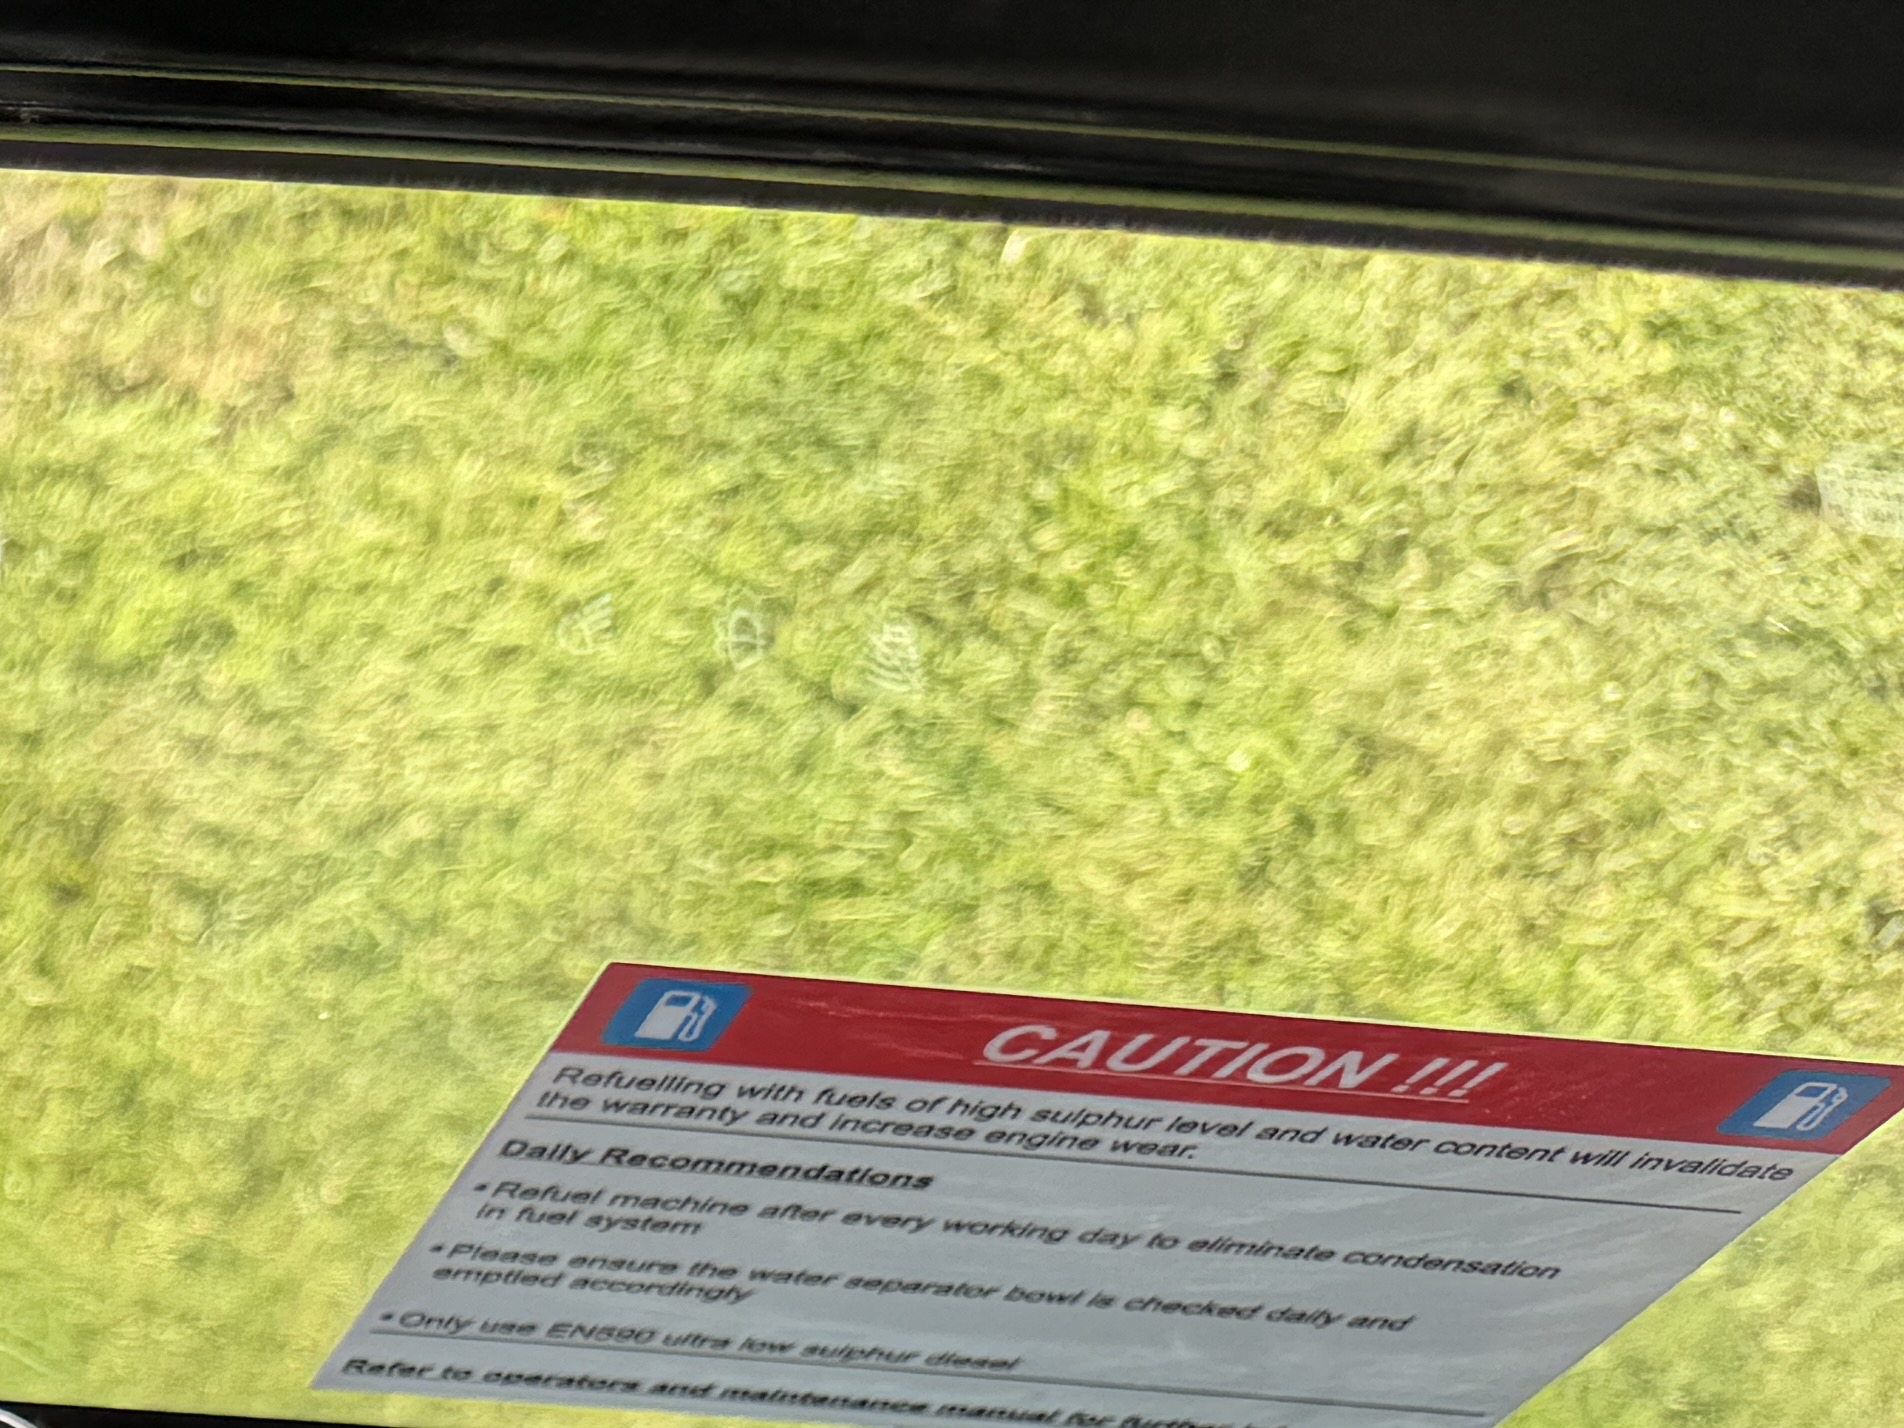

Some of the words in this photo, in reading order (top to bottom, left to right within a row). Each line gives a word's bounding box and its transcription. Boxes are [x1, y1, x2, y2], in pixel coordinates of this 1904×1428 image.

[981, 1024, 1400, 1089] CAUTION
[1391, 1056, 1509, 1098] !!!
[536, 1090, 592, 1111] the
[601, 1099, 749, 1127] warranty
[754, 1111, 825, 1129] and
[828, 1113, 975, 1141] increase
[983, 1128, 1100, 1151] engine
[1110, 1140, 1198, 1159] wear.
[552, 1066, 726, 1100] Refuelling
[737, 1082, 804, 1103] with
[812, 1087, 896, 1110] fuels
[905, 1096, 947, 1114] of
[946, 1099, 1021, 1122] high
[1028, 1108, 1163, 1131] sulphur
[1165, 1116, 1254, 1138] level
[1255, 1127, 1328, 1144] and
[1332, 1131, 1430, 1151] water
[1433, 1140, 1567, 1162] content
[1570, 1148, 1629, 1168] will
[1629, 1152, 1794, 1181] invalidate
[498, 1140, 593, 1165] Daily
[598, 1147, 934, 1190] Recommendations
[475, 1203, 506, 1219] in
[515, 1204, 578, 1225] fuel
[584, 1213, 703, 1235] system
[492, 1180, 605, 1204] Refuel
[607, 1193, 751, 1217] machine
[757, 1203, 837, 1221] after
[841, 1212, 935, 1234] every
[942, 1220, 1070, 1245] working
[1077, 1227, 1141, 1249] day
[1146, 1232, 1180, 1250] to
[1188, 1236, 1336, 1261] eliminate
[1342, 1251, 1562, 1279] condensation
[432, 1267, 565, 1288] emptied
[569, 1278, 758, 1305] accordingly
[447, 1242, 559, 1266] Please
[568, 1256, 678, 1275] ensure
[688, 1262, 738, 1280] the
[748, 1268, 842, 1287] water
[844, 1276, 1000, 1299] separator
[1003, 1285, 1085, 1305] bowl
[1086, 1290, 1116, 1309] is
[1123, 1295, 1264, 1320] checked
[1265, 1305, 1345, 1329] daily
[1347, 1314, 1416, 1331] and
[399, 1312, 472, 1335] Only
[480, 1320, 539, 1336] use
[545, 1322, 657, 1343] EN590
[662, 1331, 732, 1351] ultra
[739, 1337, 795, 1353] low
[799, 1343, 921, 1363] sulphur
[924, 1350, 1023, 1371] diesel
[343, 1358, 433, 1378] Refer
[441, 1366, 472, 1381] to
[482, 1372, 640, 1393] operators
[648, 1381, 716, 1398] and
[719, 1387, 929, 1414] maintenance
[934, 1403, 1063, 1424] manual
[1064, 1410, 1116, 1428] for
